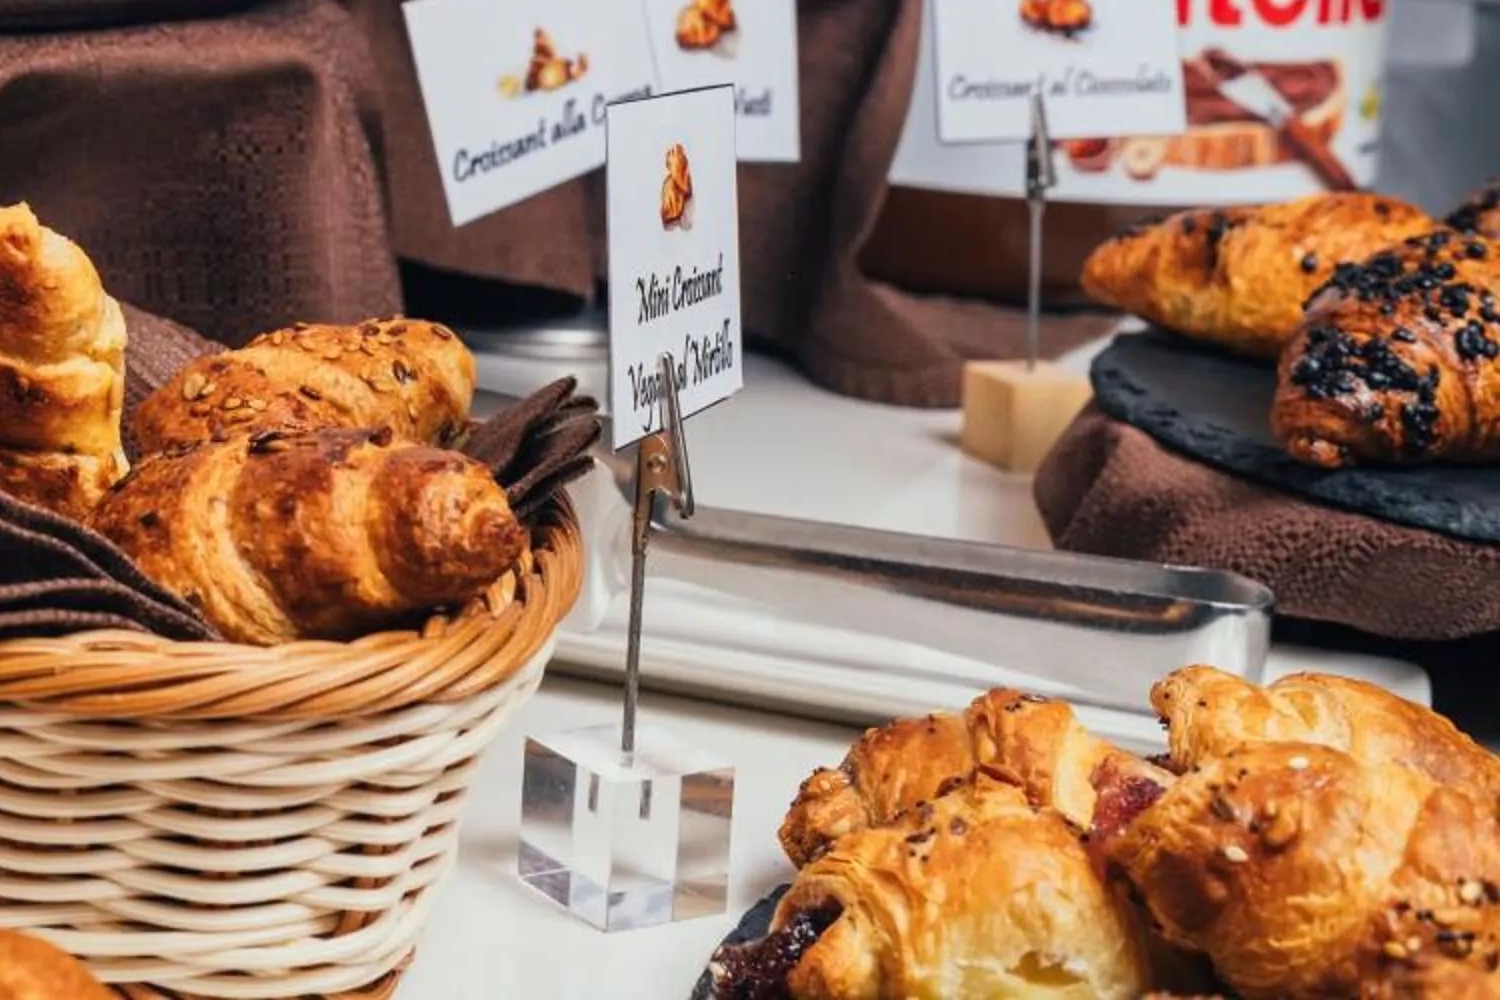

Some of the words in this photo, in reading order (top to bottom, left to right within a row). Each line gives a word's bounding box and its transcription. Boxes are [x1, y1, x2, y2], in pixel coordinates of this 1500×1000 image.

[635, 272, 671, 326] Mini
[672, 251, 724, 312] Croissant
[689, 317, 733, 386] Mirtillo
